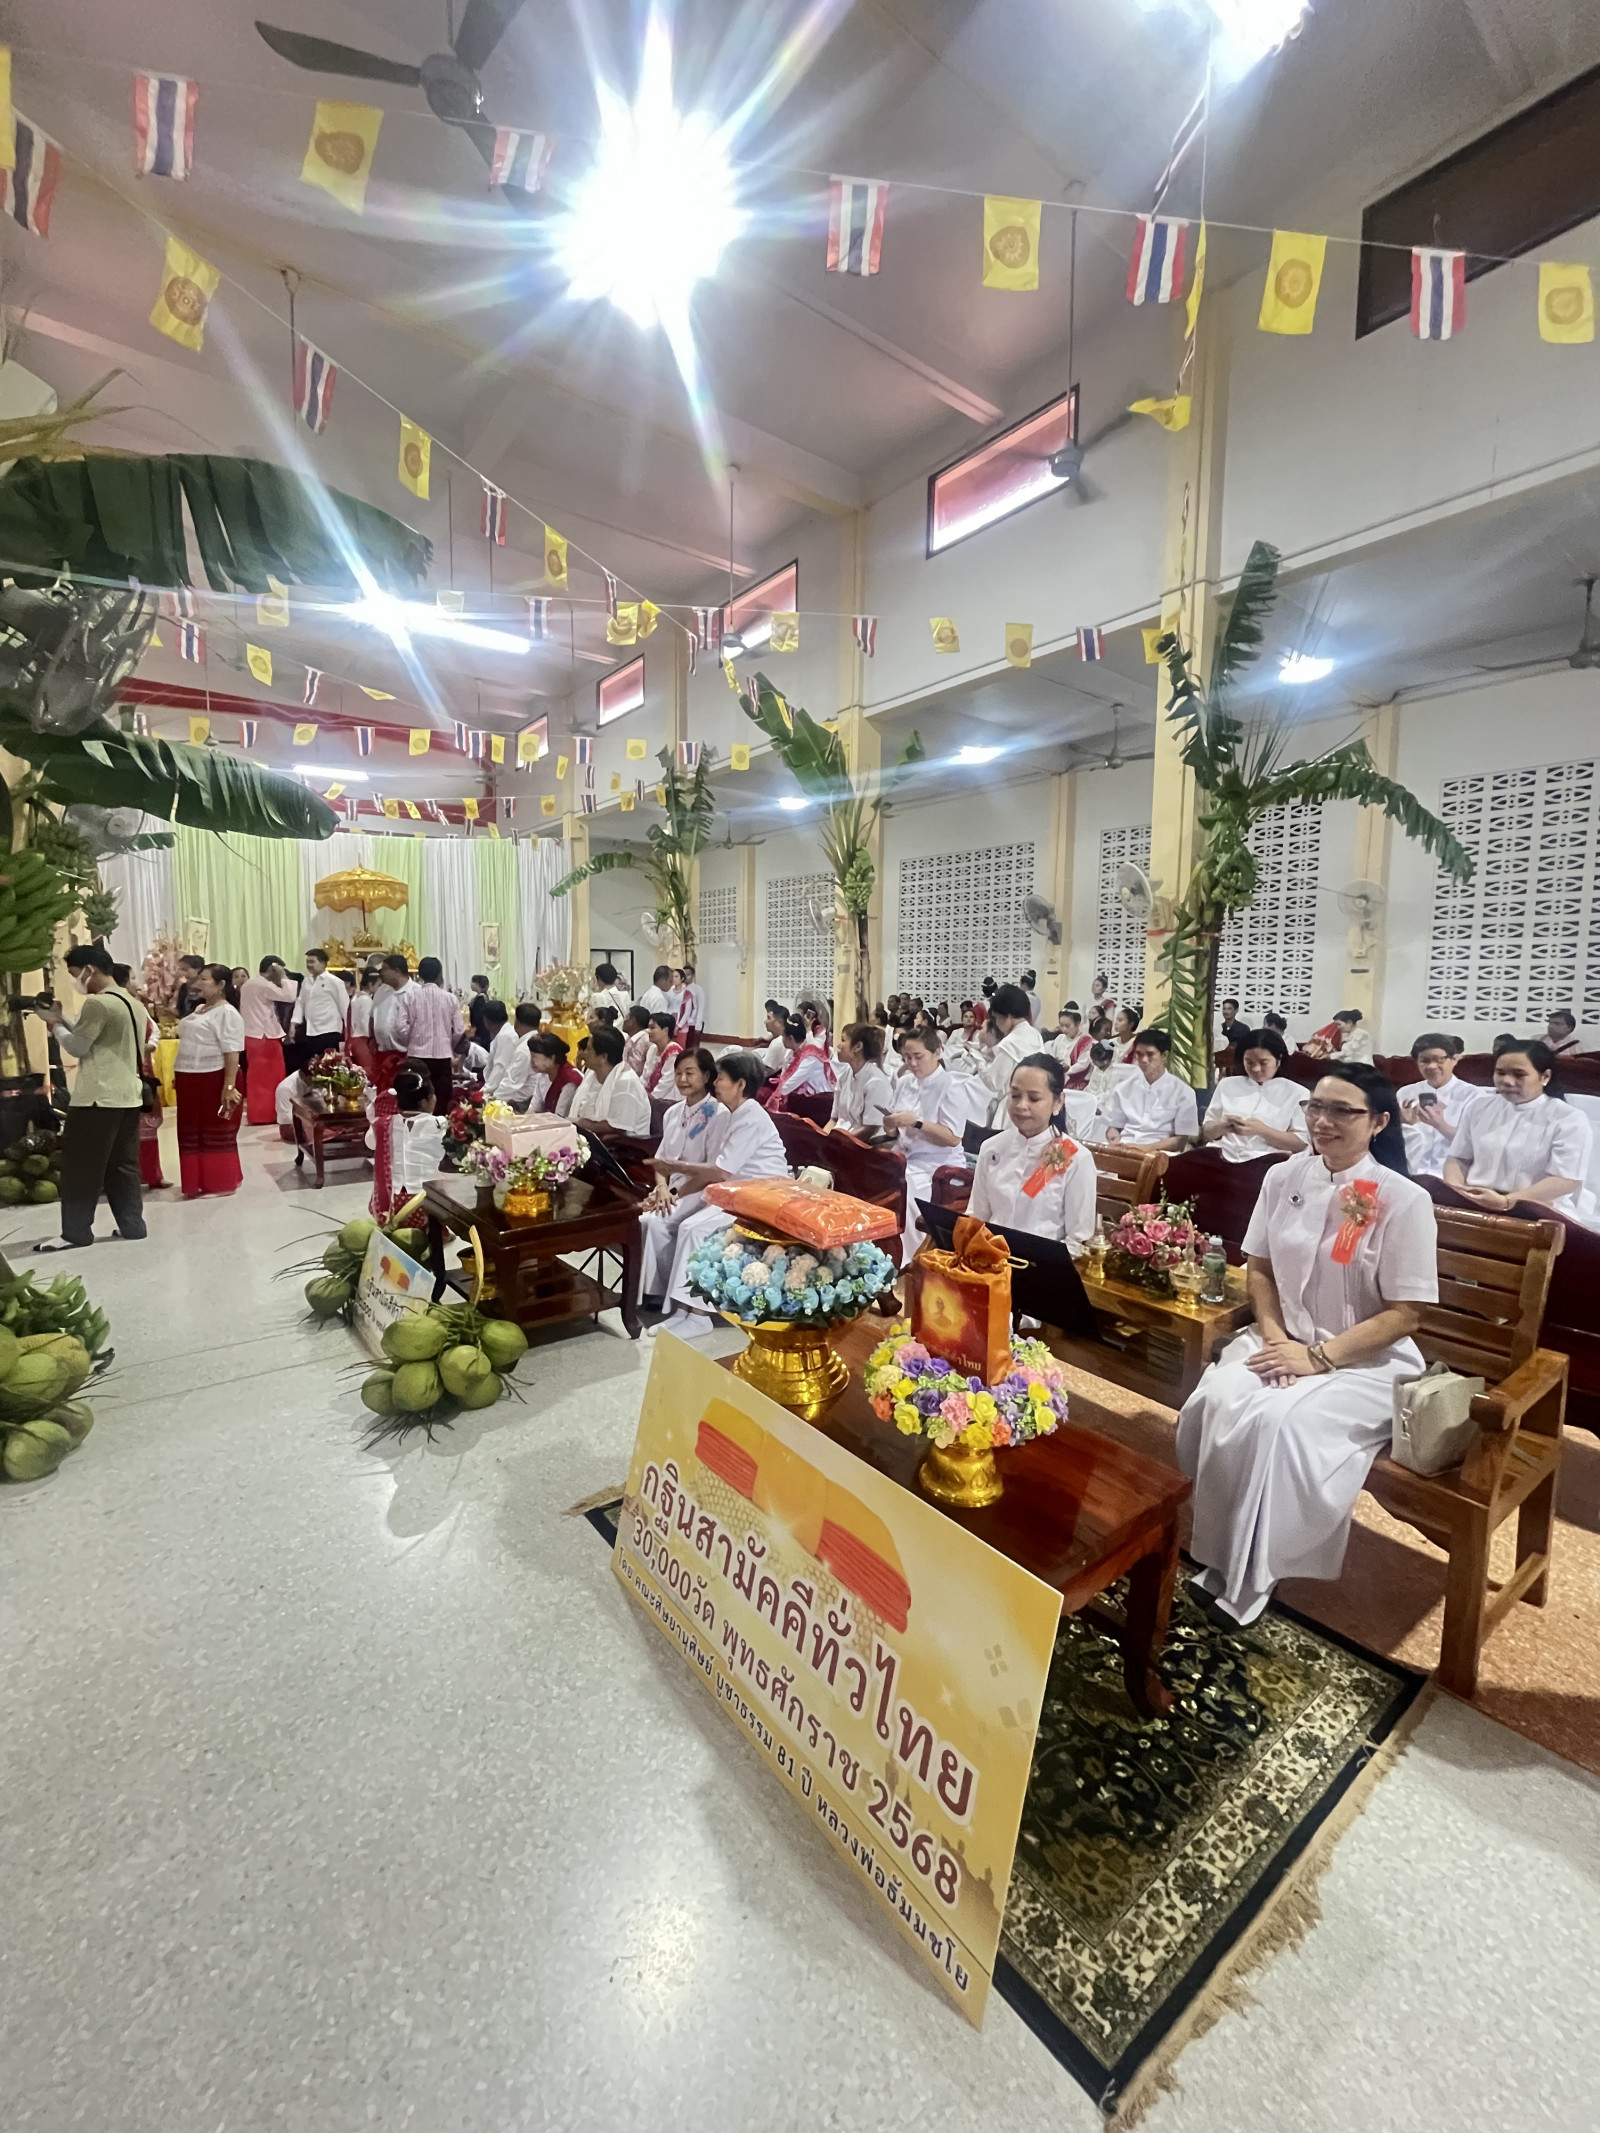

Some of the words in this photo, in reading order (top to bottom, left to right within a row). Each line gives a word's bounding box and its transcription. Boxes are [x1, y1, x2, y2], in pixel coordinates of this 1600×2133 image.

[618, 1547, 633, 1580] โดย
[717, 1672, 773, 1751] บูชาธรรม
[777, 1745, 794, 1778] 81
[801, 1766, 813, 1797] ปี
[817, 1793, 968, 1991] หลวงพ่อธัมมชโย
[643, 1463, 973, 1816] กฐินสามัคคีทั่วไทย
[722, 1619, 860, 1791] พุทธศักราช
[868, 1778, 958, 1904] 2568
